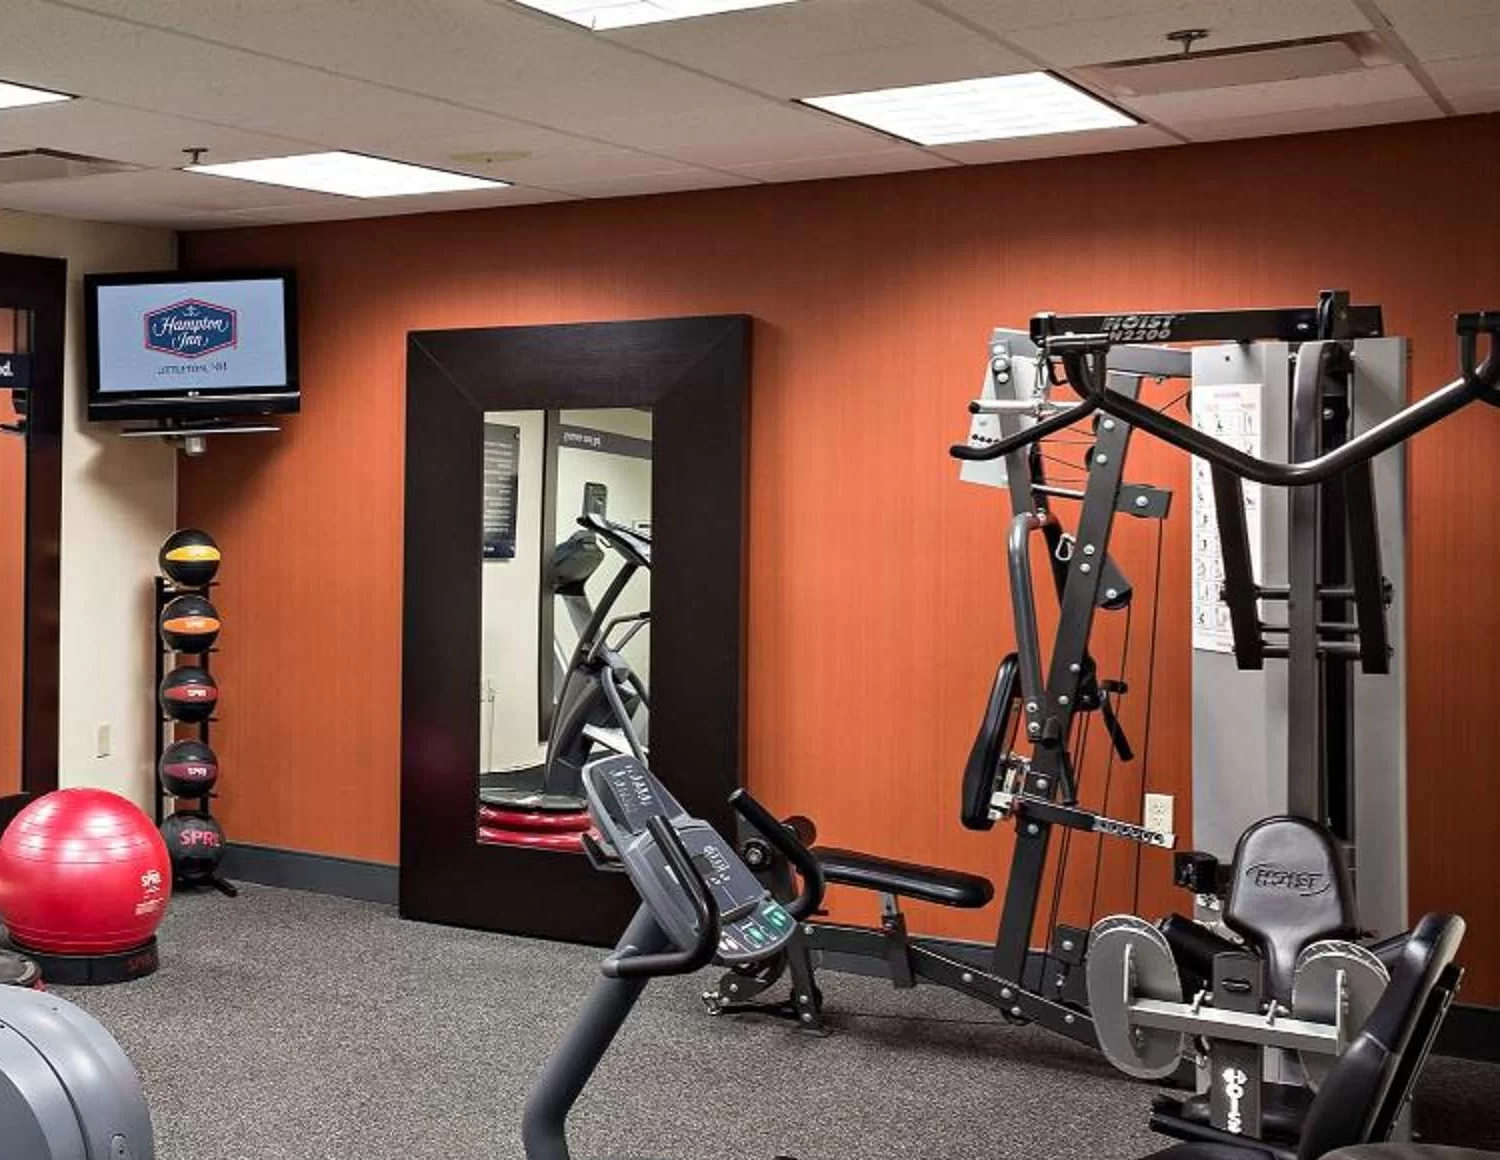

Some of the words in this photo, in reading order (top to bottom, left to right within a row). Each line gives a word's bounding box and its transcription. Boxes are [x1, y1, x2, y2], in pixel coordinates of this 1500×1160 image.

[152, 315, 230, 338] Hampton
[1102, 315, 1177, 330] HOIST
[171, 331, 210, 350] Inn
